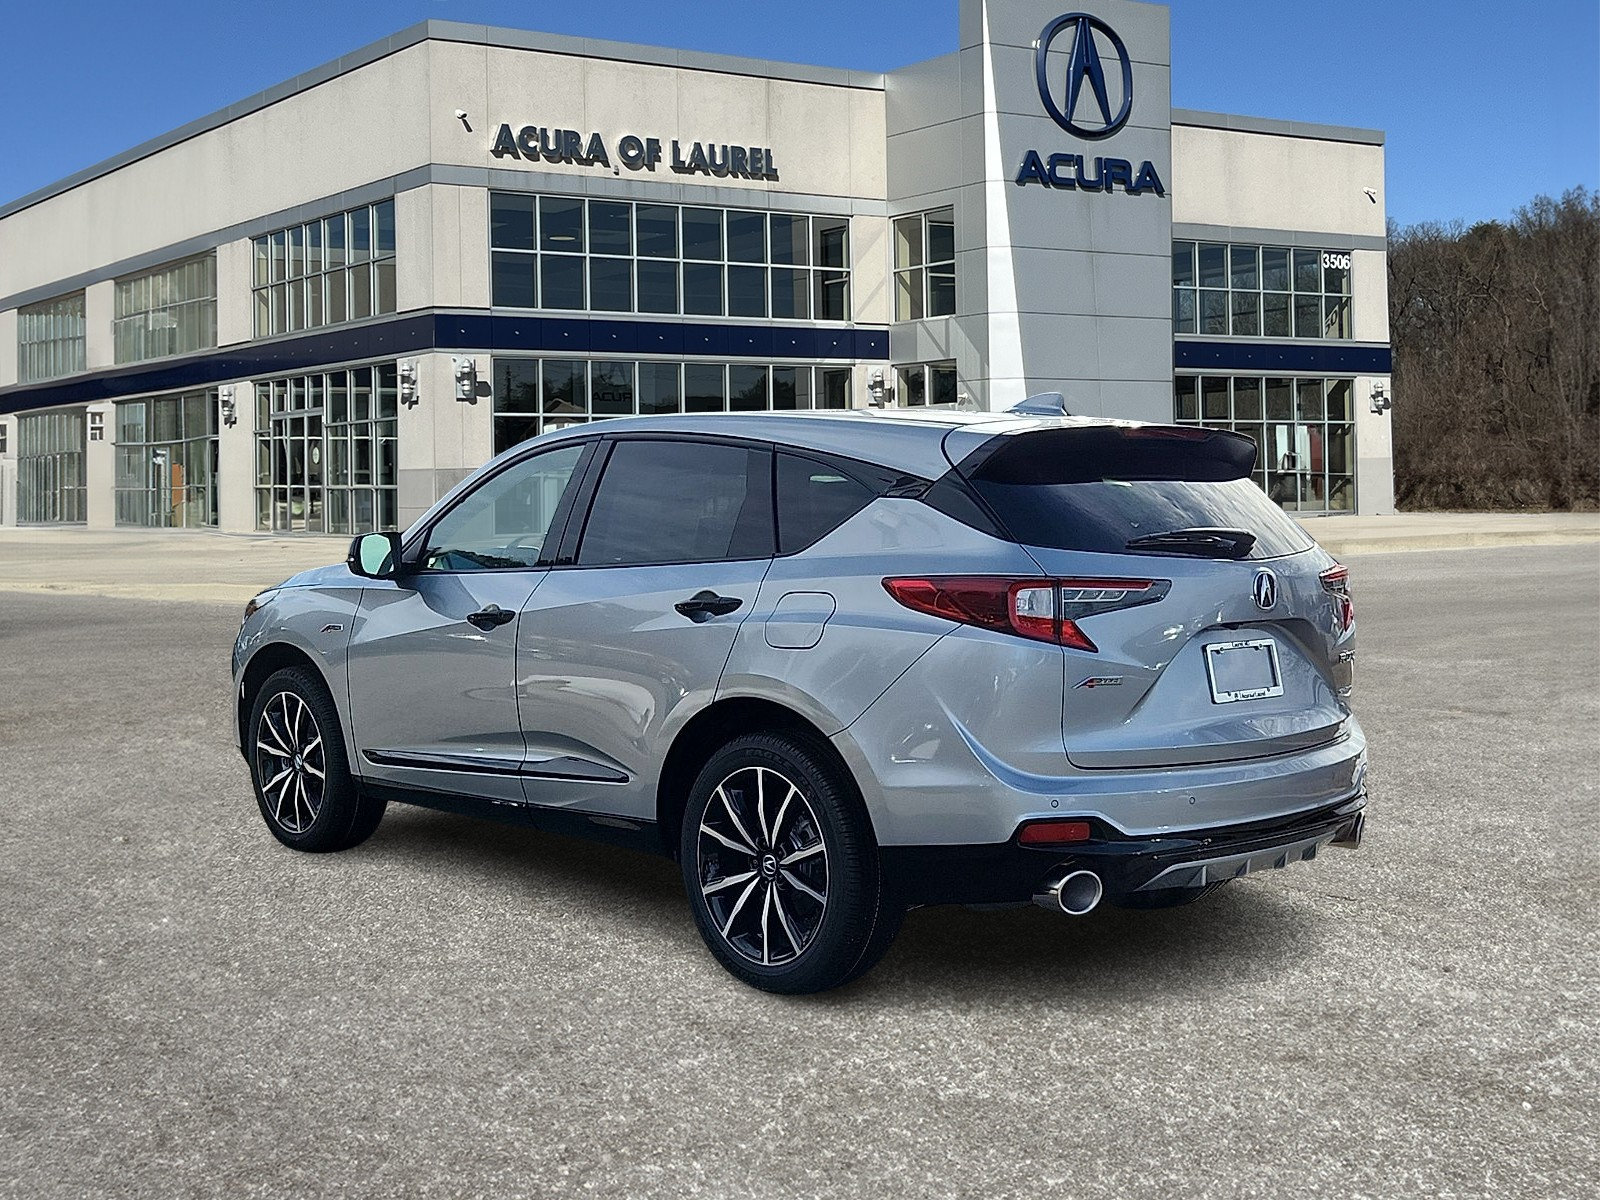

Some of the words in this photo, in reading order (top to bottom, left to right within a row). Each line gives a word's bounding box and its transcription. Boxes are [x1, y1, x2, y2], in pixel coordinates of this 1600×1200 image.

[490, 123, 611, 169] ACURA
[616, 135, 662, 172] OF
[670, 140, 779, 182] LAUREL
[1015, 150, 1165, 198] ACURA
[1322, 253, 1351, 270] 3506
